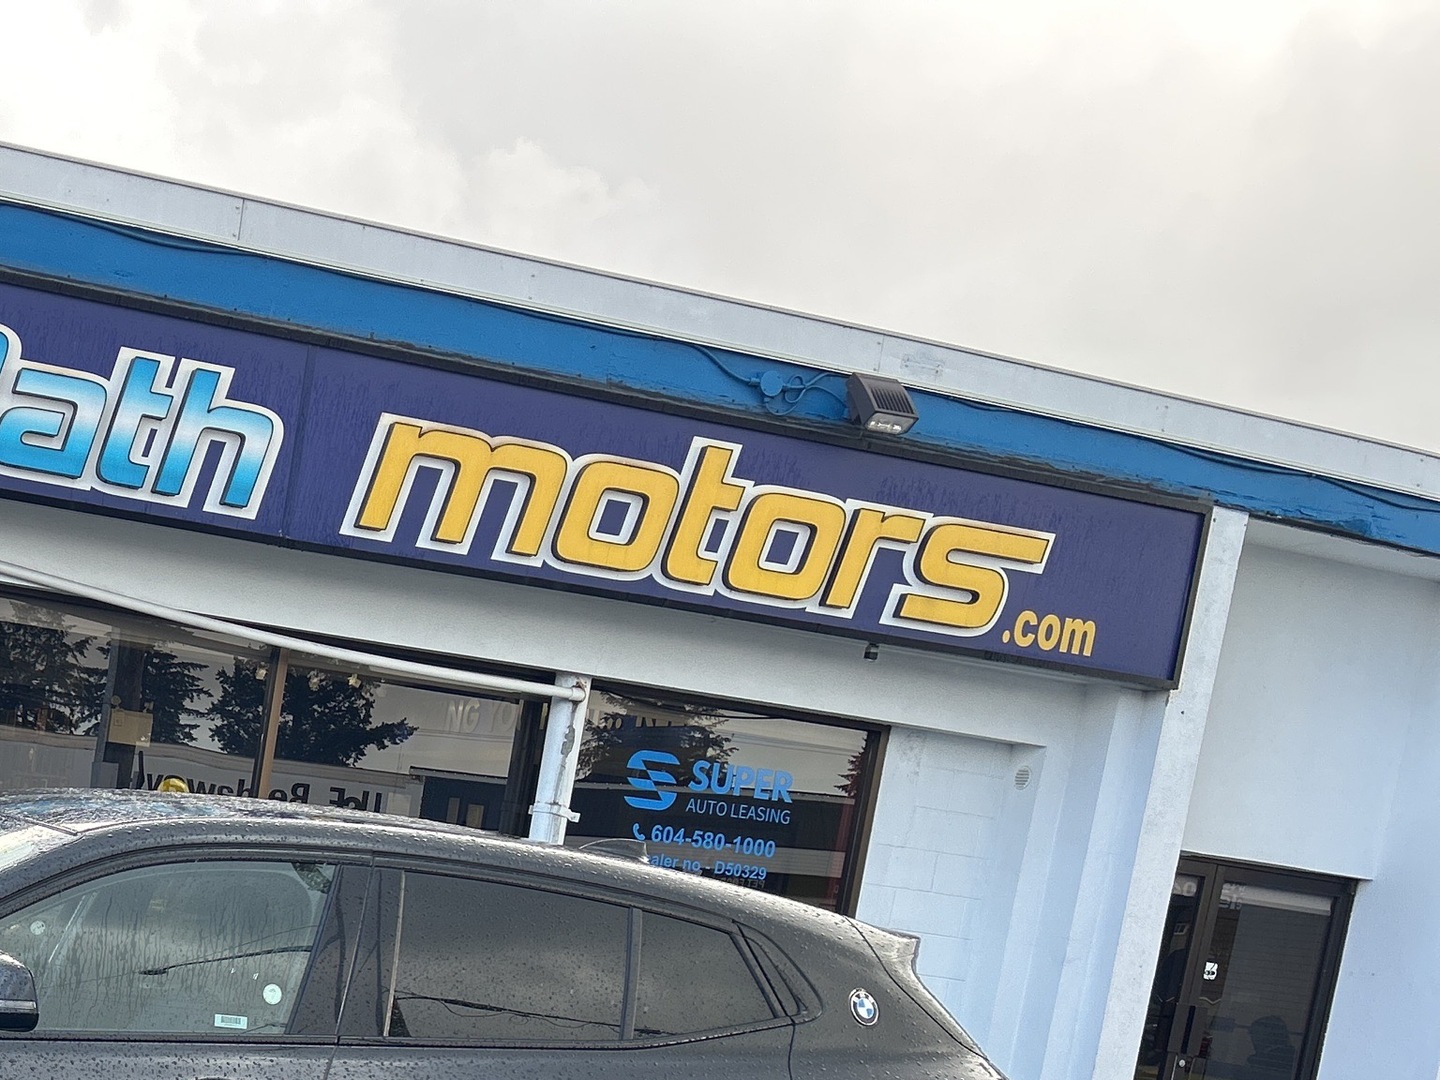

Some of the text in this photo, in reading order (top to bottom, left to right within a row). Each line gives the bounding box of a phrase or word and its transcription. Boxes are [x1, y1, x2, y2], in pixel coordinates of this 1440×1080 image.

[340, 412, 1056, 636] motors
[688, 760, 794, 803] SUPER
[686, 798, 792, 824] AUTO LEASING
[651, 824, 776, 858] 604-580-1000
[650, 853, 679, 868] aler
[683, 859, 701, 871] no
[714, 860, 768, 880] D50329
